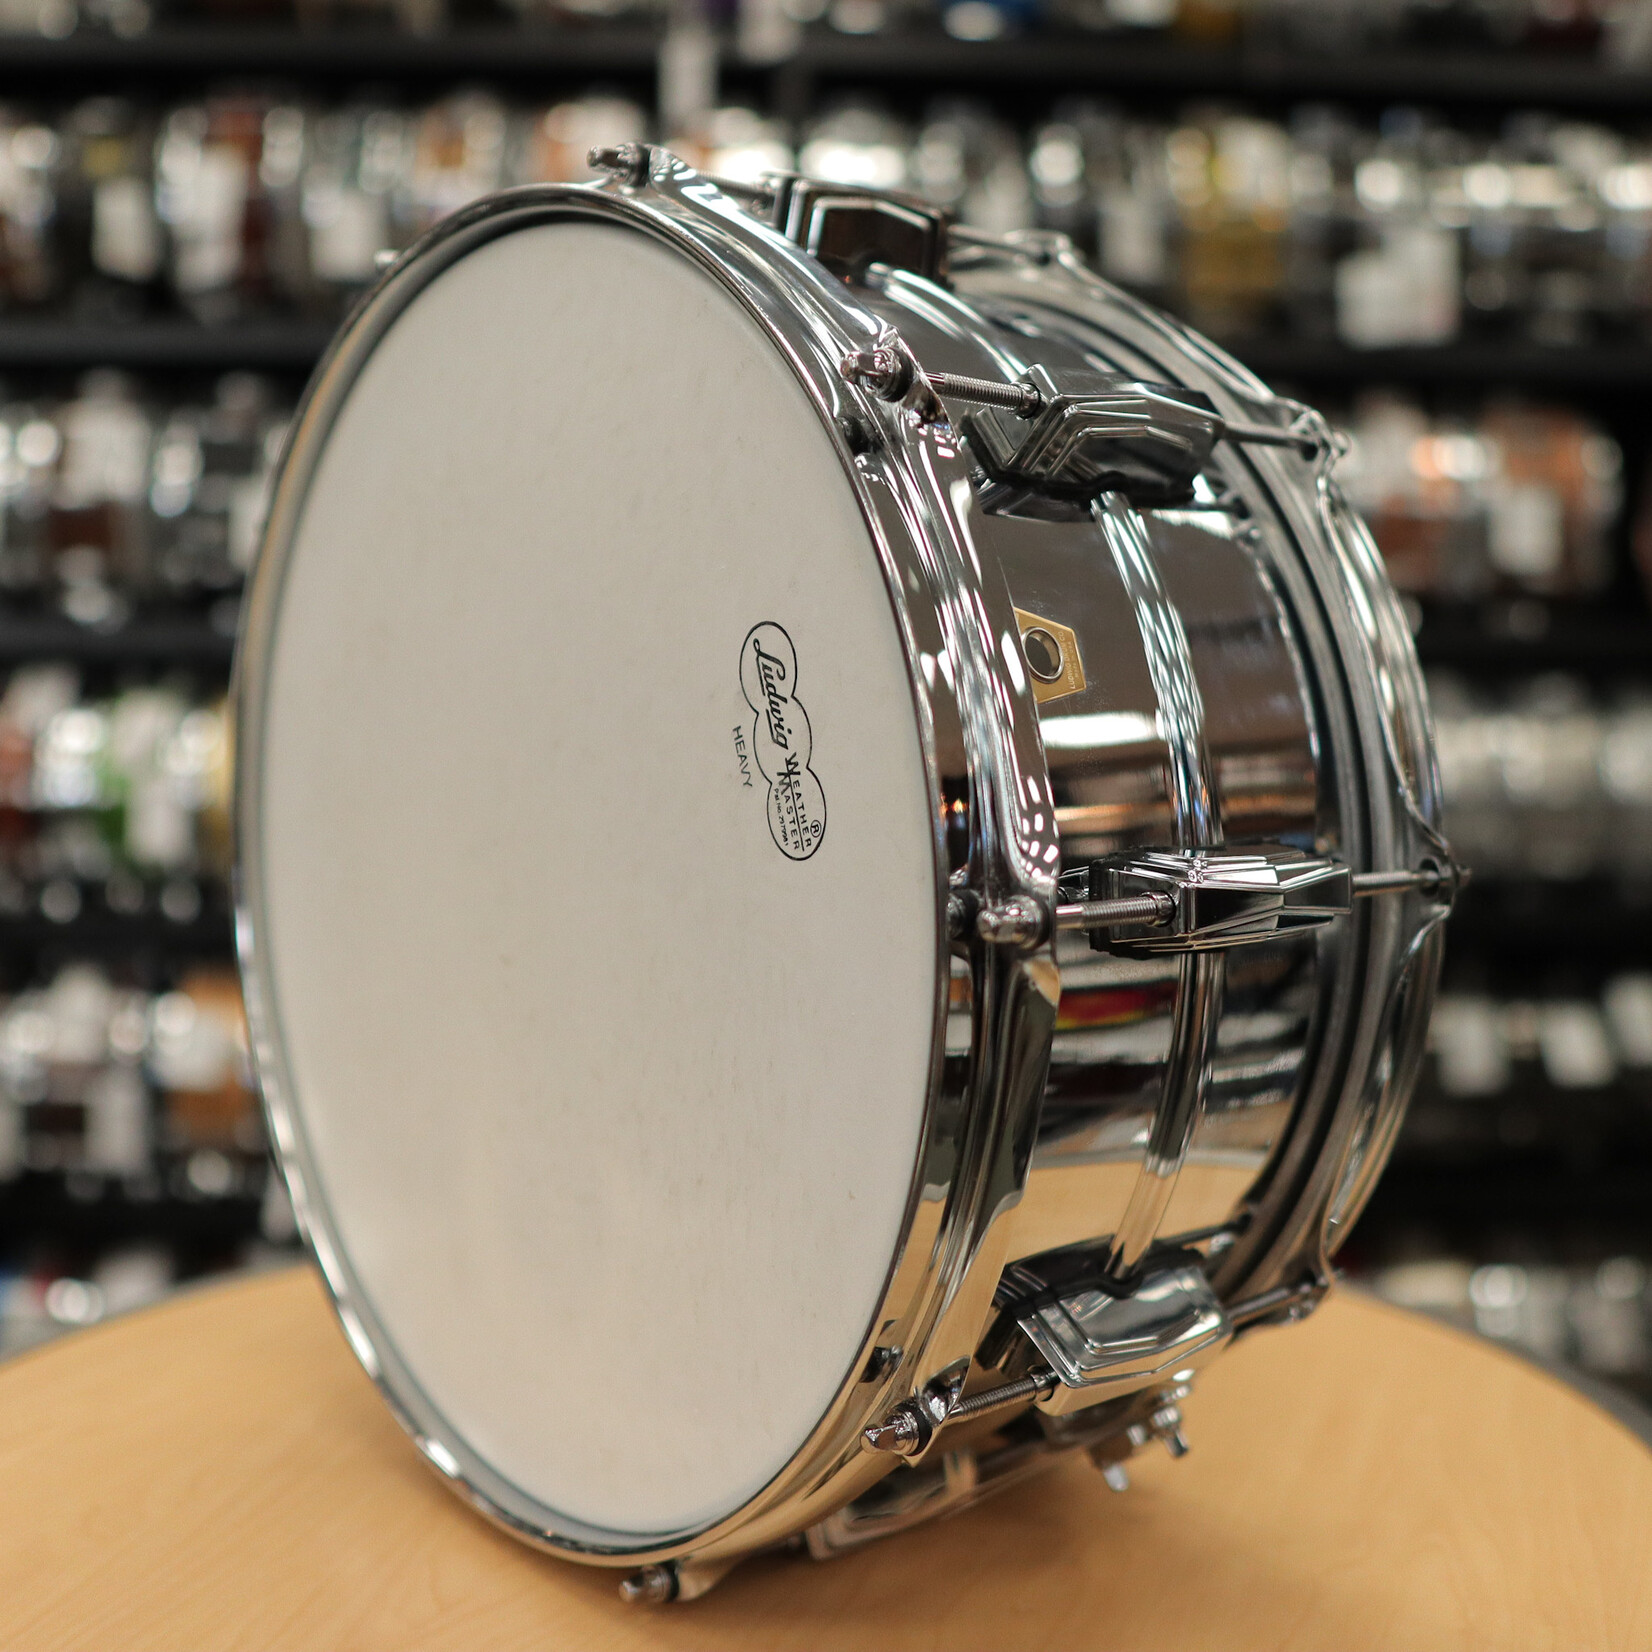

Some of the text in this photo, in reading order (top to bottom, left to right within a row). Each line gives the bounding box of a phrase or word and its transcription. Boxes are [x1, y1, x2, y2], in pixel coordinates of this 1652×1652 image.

[753, 638, 793, 750] Ludwig
[1065, 662, 1076, 689] LUDWIG
[732, 725, 753, 788] HEAVY
[777, 771, 800, 850] MASTER
[785, 752, 812, 848] WEATHER
